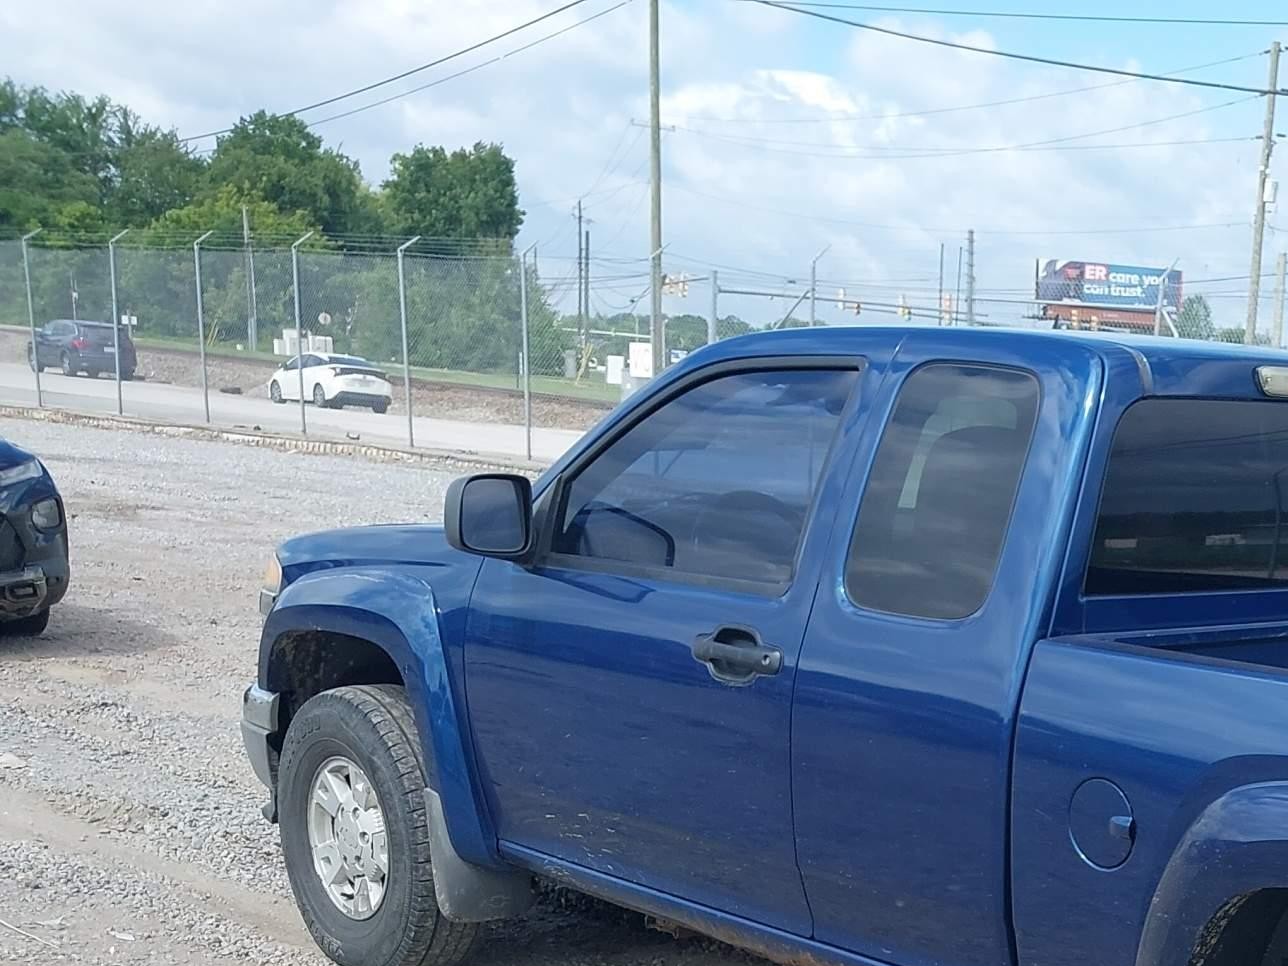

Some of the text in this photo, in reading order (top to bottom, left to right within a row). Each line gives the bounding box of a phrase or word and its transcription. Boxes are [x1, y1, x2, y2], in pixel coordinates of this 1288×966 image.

[1084, 264, 1107, 281] ER
[1109, 271, 1140, 285] care
[1083, 283, 1146, 297] can trust.
